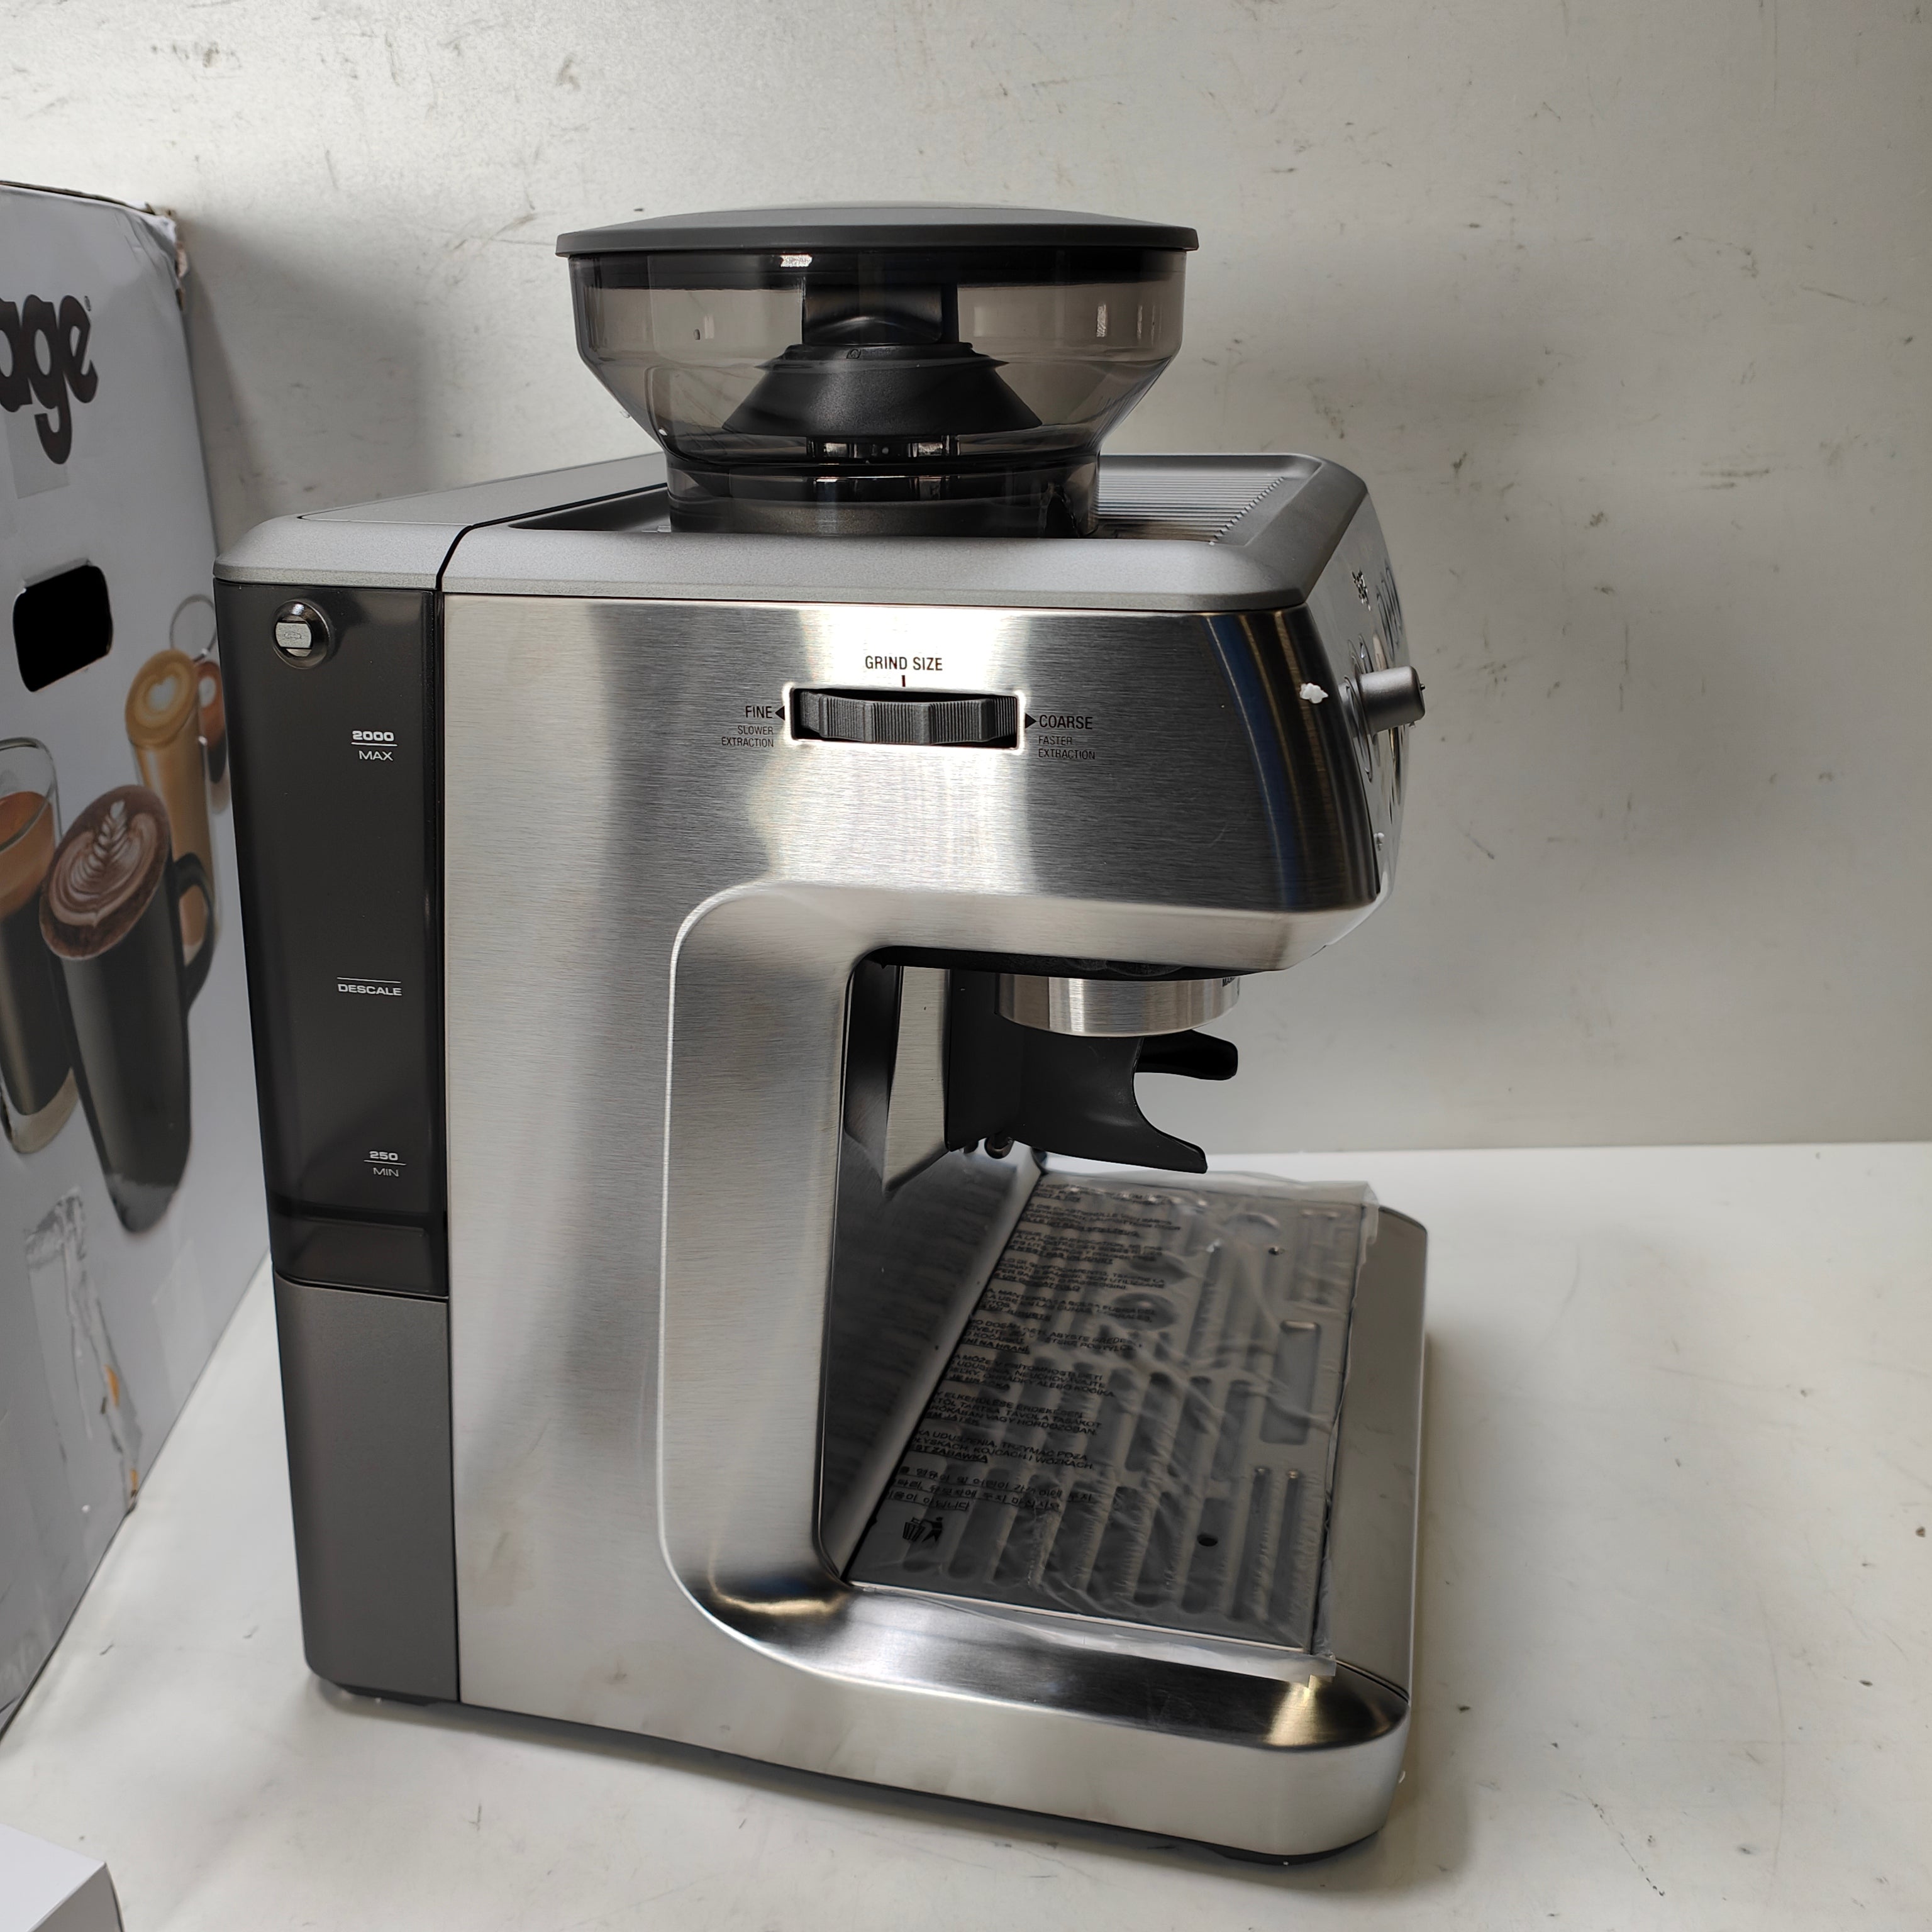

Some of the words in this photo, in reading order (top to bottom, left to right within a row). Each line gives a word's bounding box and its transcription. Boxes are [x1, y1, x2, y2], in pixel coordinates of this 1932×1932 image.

[865, 655, 908, 670] GRIND
[913, 657, 943, 671] SIZE
[745, 706, 773, 719] FINE
[1039, 714, 1093, 730] COARSE
[737, 724, 774, 735] SLOWER
[352, 730, 395, 742] 2000
[721, 736, 774, 747] EXTRACTION
[1038, 735, 1073, 746] FASTER
[358, 750, 394, 761] MAX
[1038, 748, 1096, 760] EXTRACTION
[337, 984, 402, 996] DESCALE
[369, 1150, 399, 1161] 250
[373, 1167, 399, 1177] MIN
